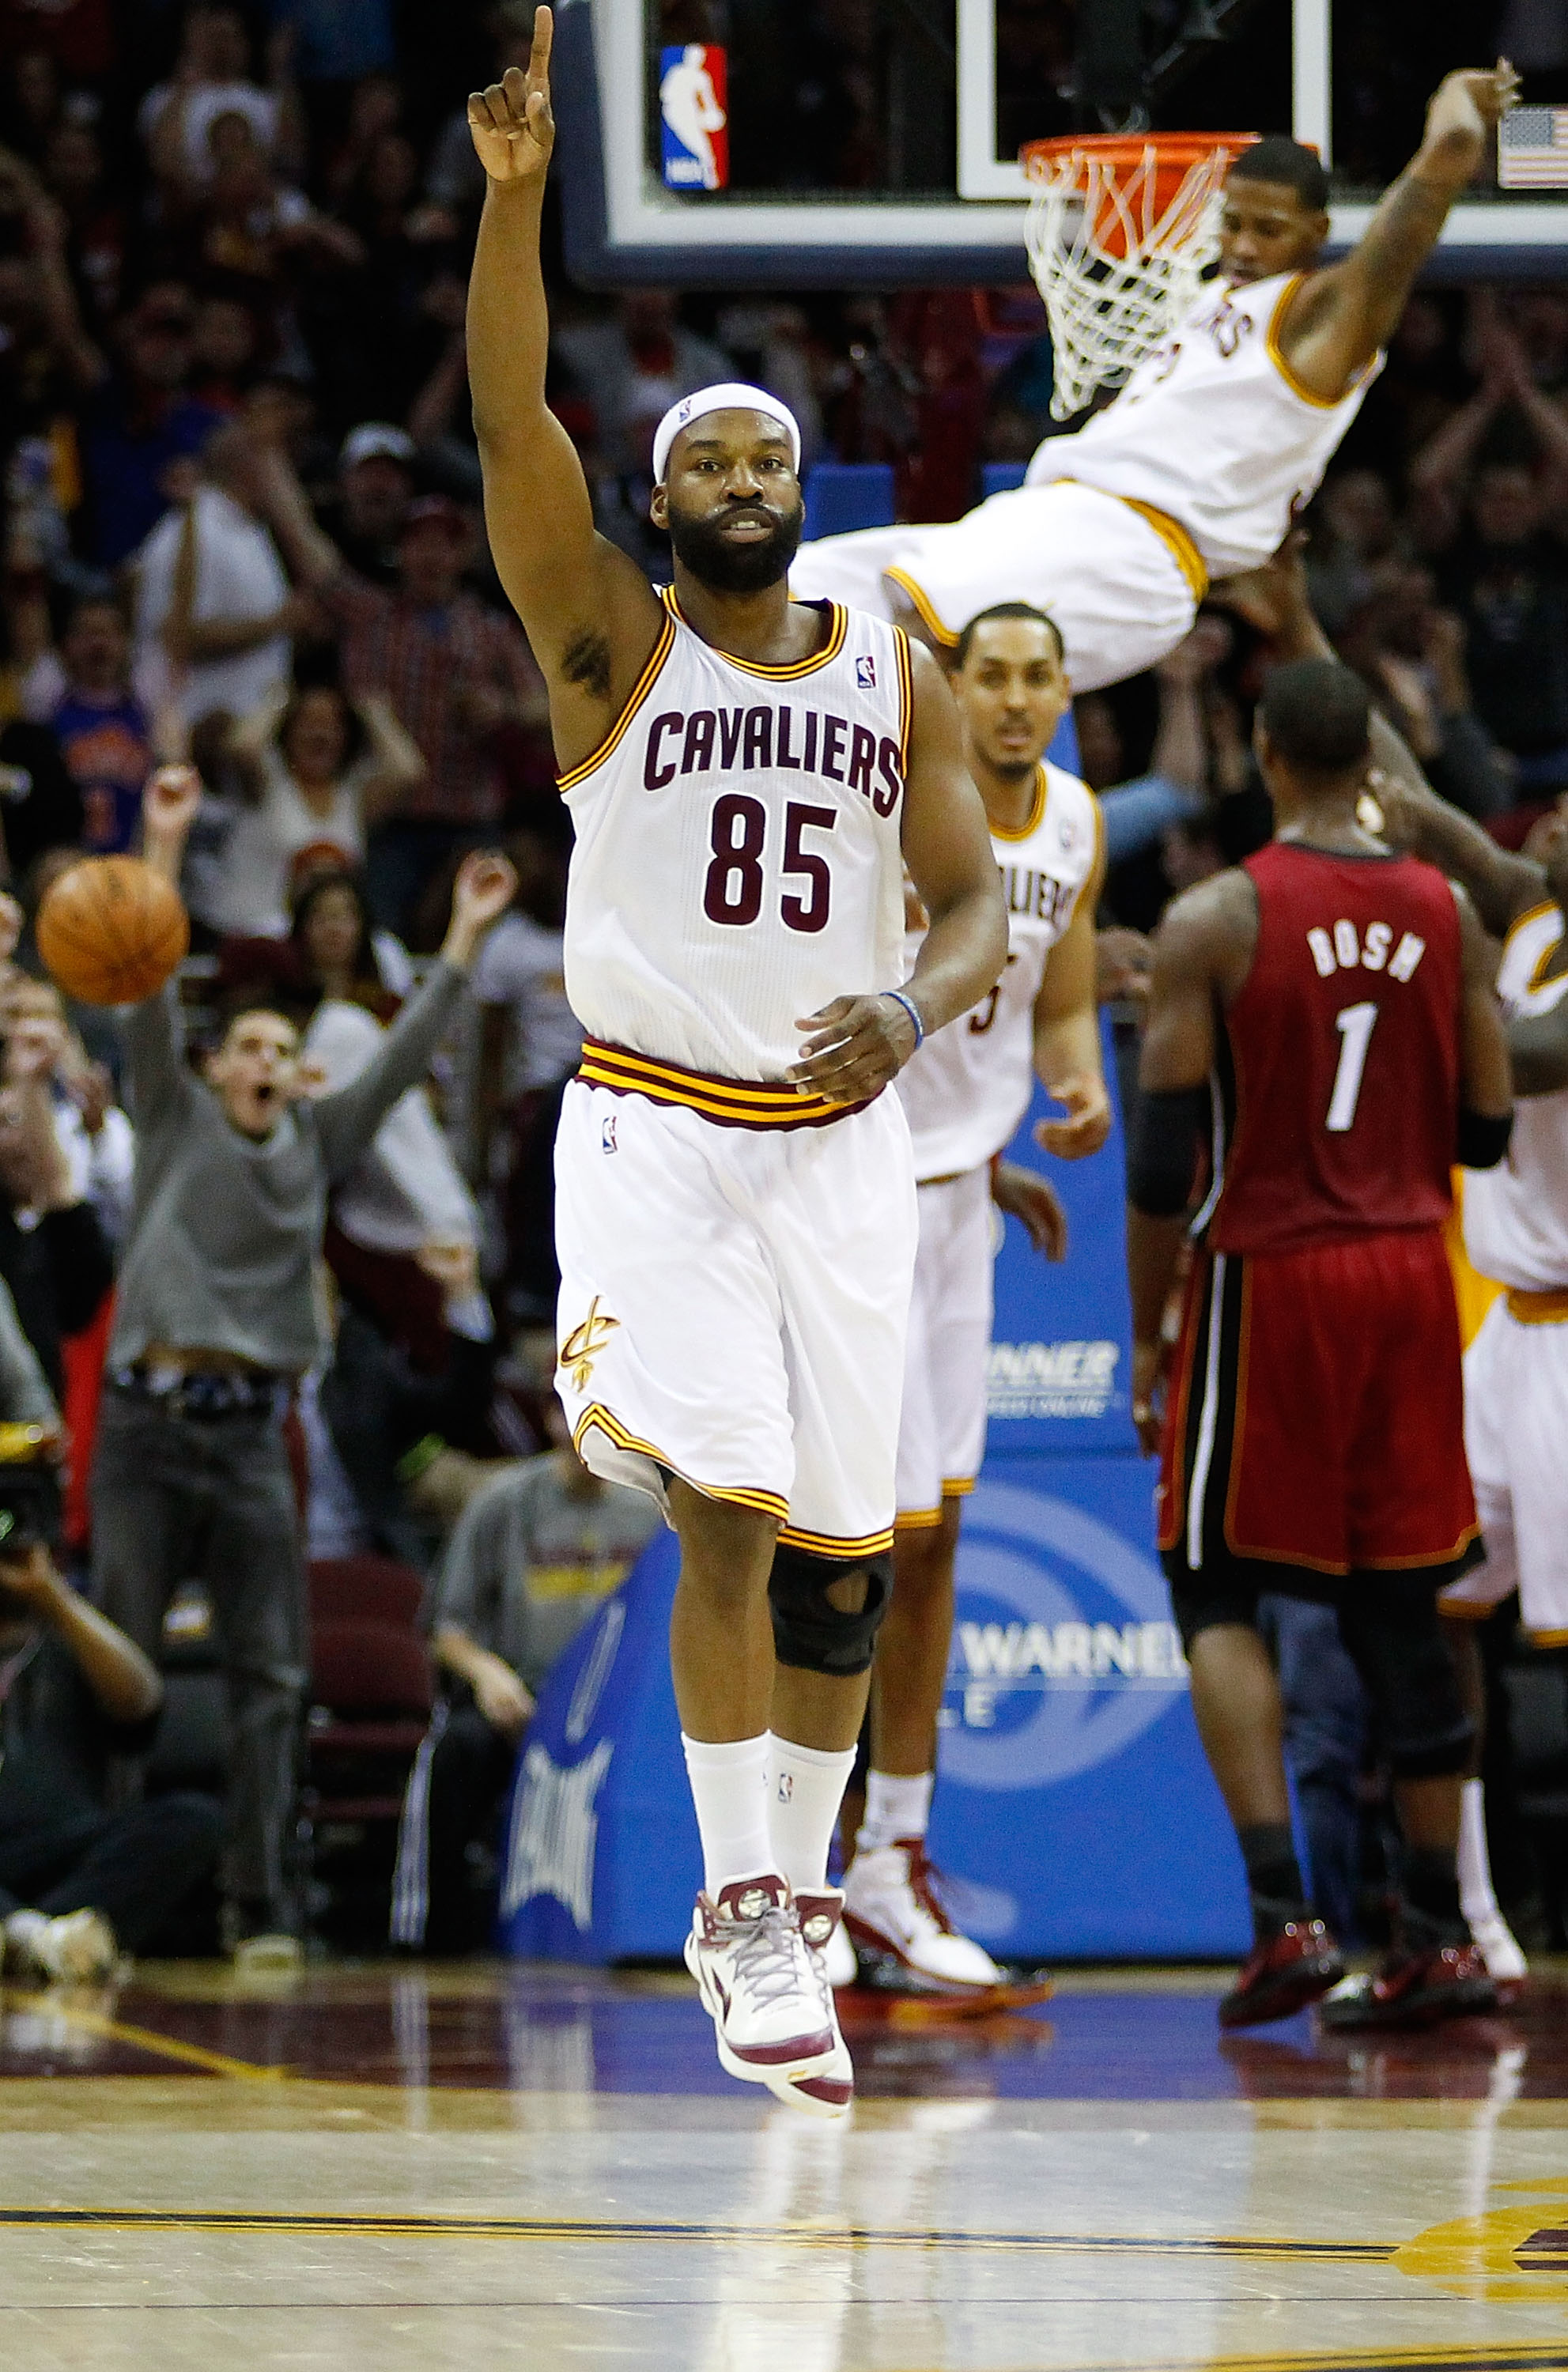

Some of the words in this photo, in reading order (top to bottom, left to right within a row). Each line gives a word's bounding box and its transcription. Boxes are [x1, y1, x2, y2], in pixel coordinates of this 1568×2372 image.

[644, 705, 901, 818] CAVALIERS
[704, 793, 837, 933] 85
[1306, 919, 1426, 983] BOSH
[1325, 1000, 1379, 1132] 1
[988, 1341, 1119, 1386] NNER
